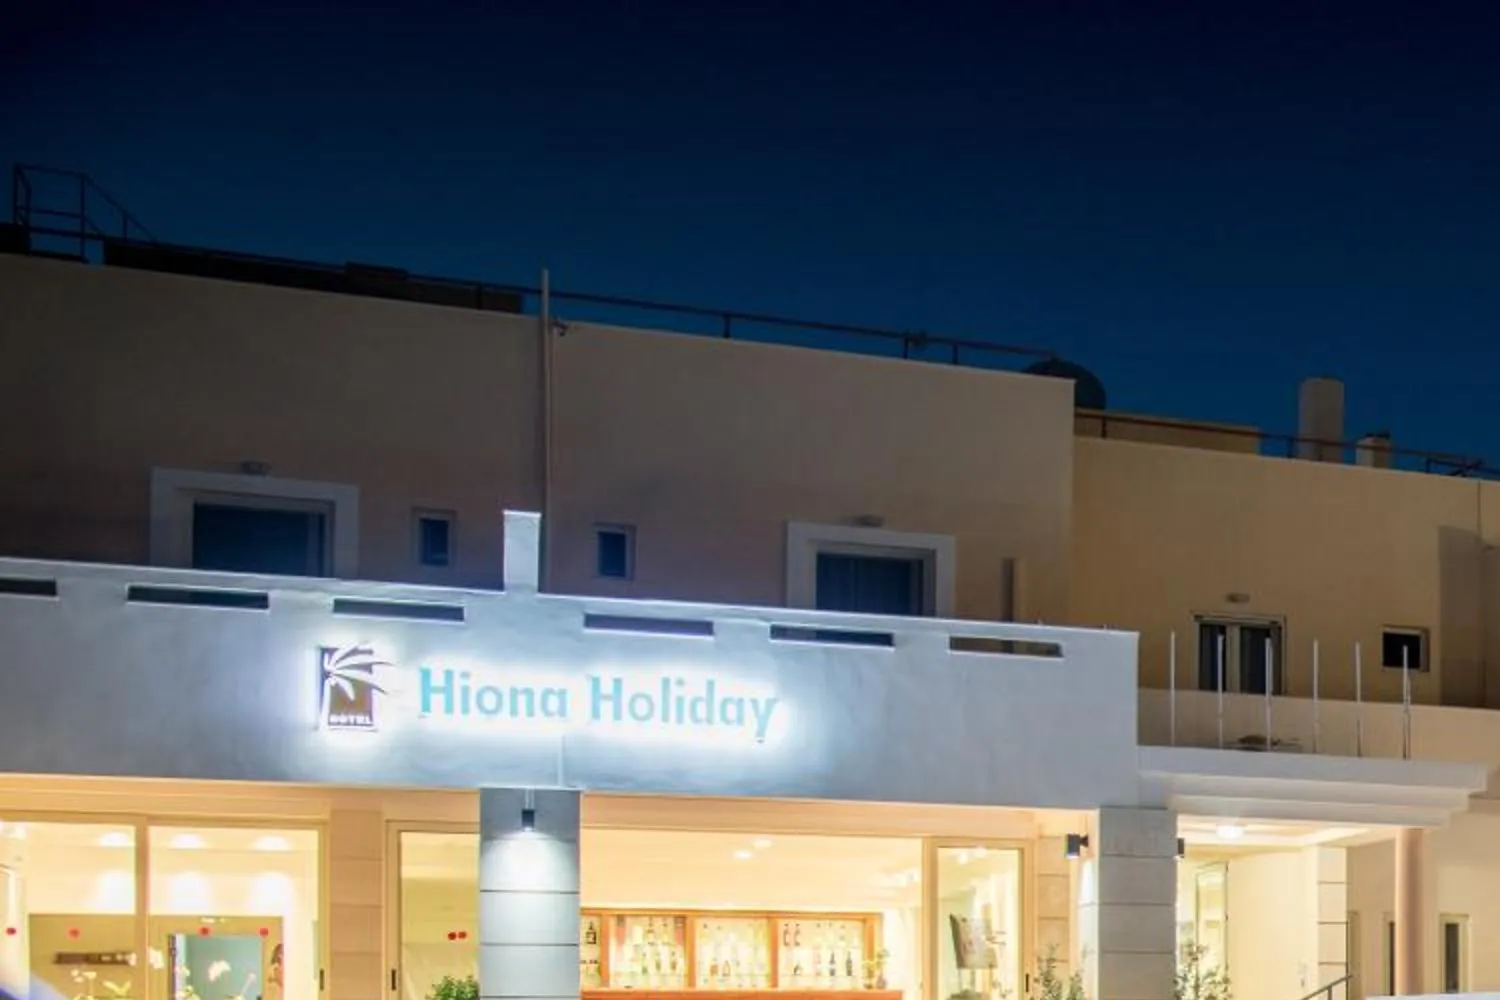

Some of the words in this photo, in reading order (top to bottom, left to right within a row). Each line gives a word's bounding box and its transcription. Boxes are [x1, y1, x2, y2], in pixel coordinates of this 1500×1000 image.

[328, 714, 372, 725] HOTEL
[420, 667, 569, 718] Hiona
[589, 675, 779, 744] Holiday
